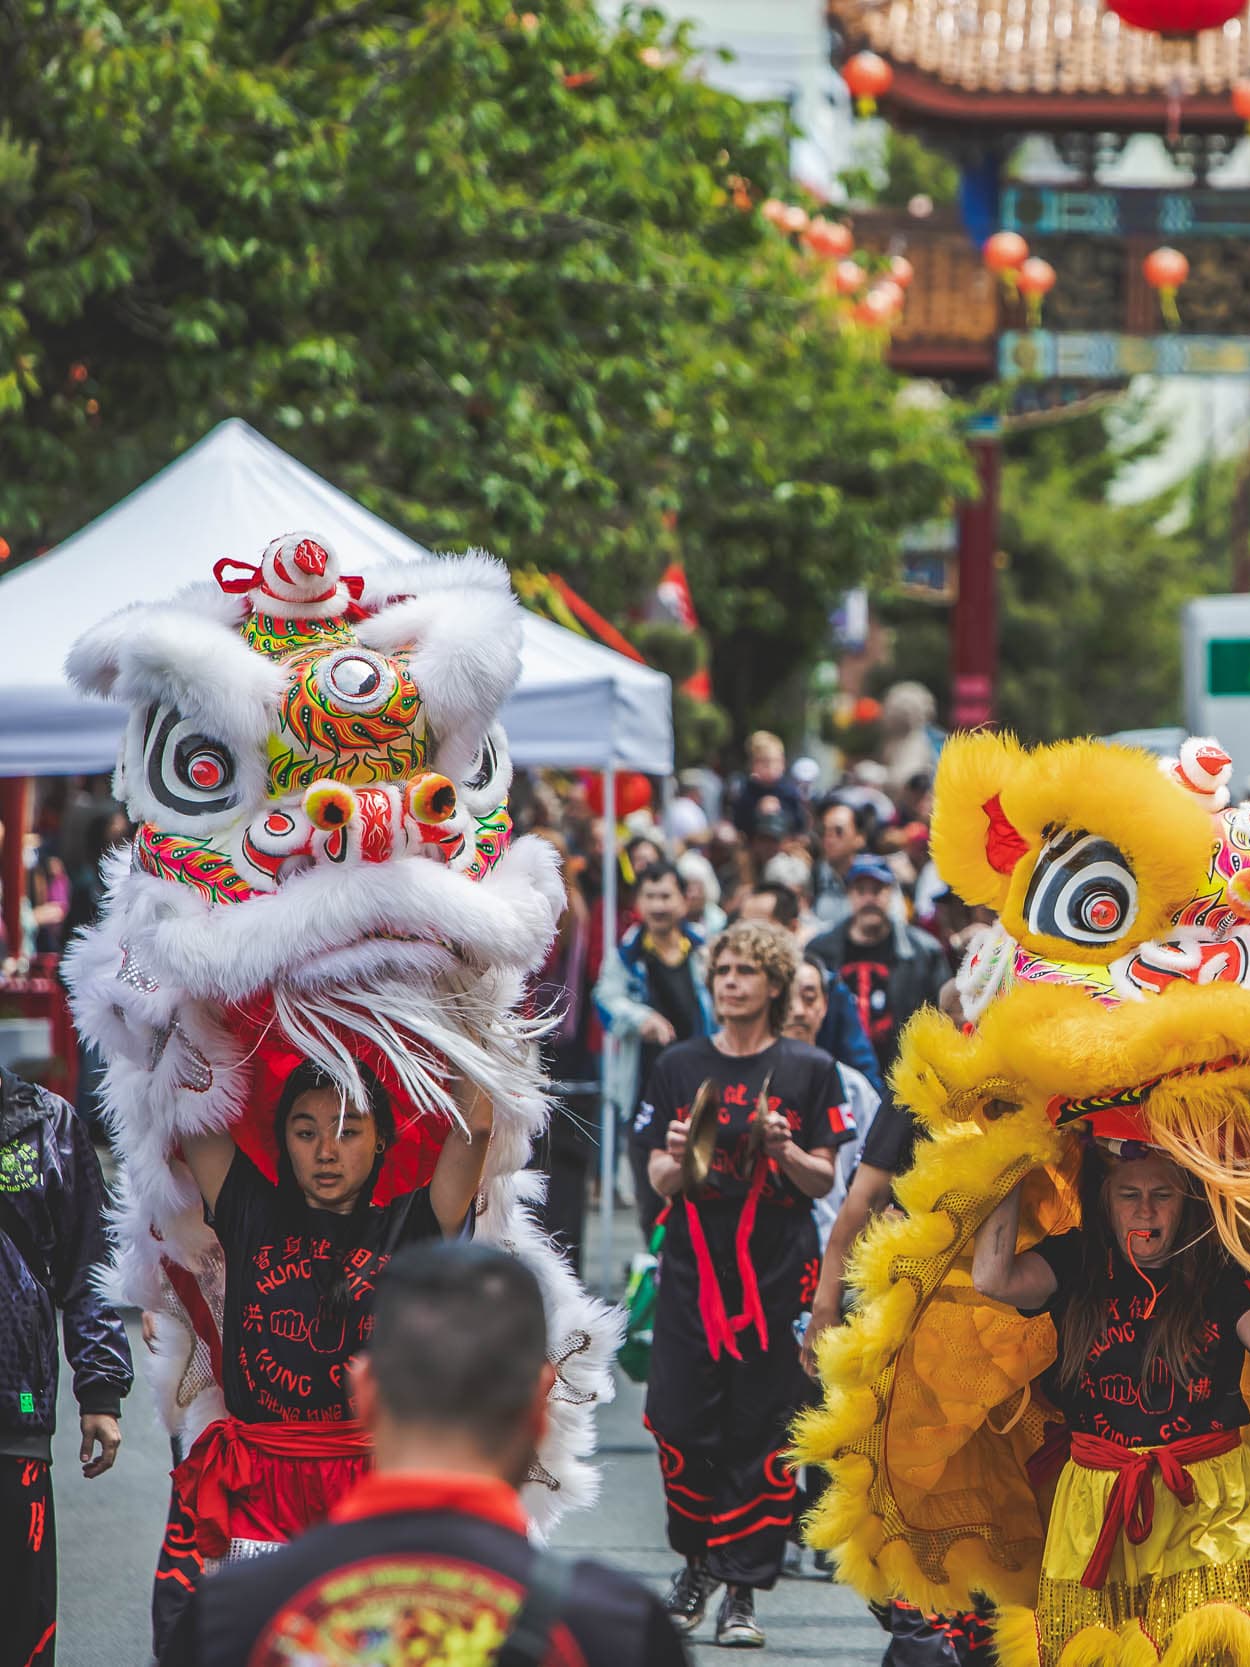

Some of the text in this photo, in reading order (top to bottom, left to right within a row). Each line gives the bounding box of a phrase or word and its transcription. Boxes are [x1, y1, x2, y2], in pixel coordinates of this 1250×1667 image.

[256, 1259, 312, 1295] HUNG
[243, 1303, 264, 1334] 洪
[255, 1348, 312, 1397] KUNG
[1159, 1415, 1191, 1440] FU
